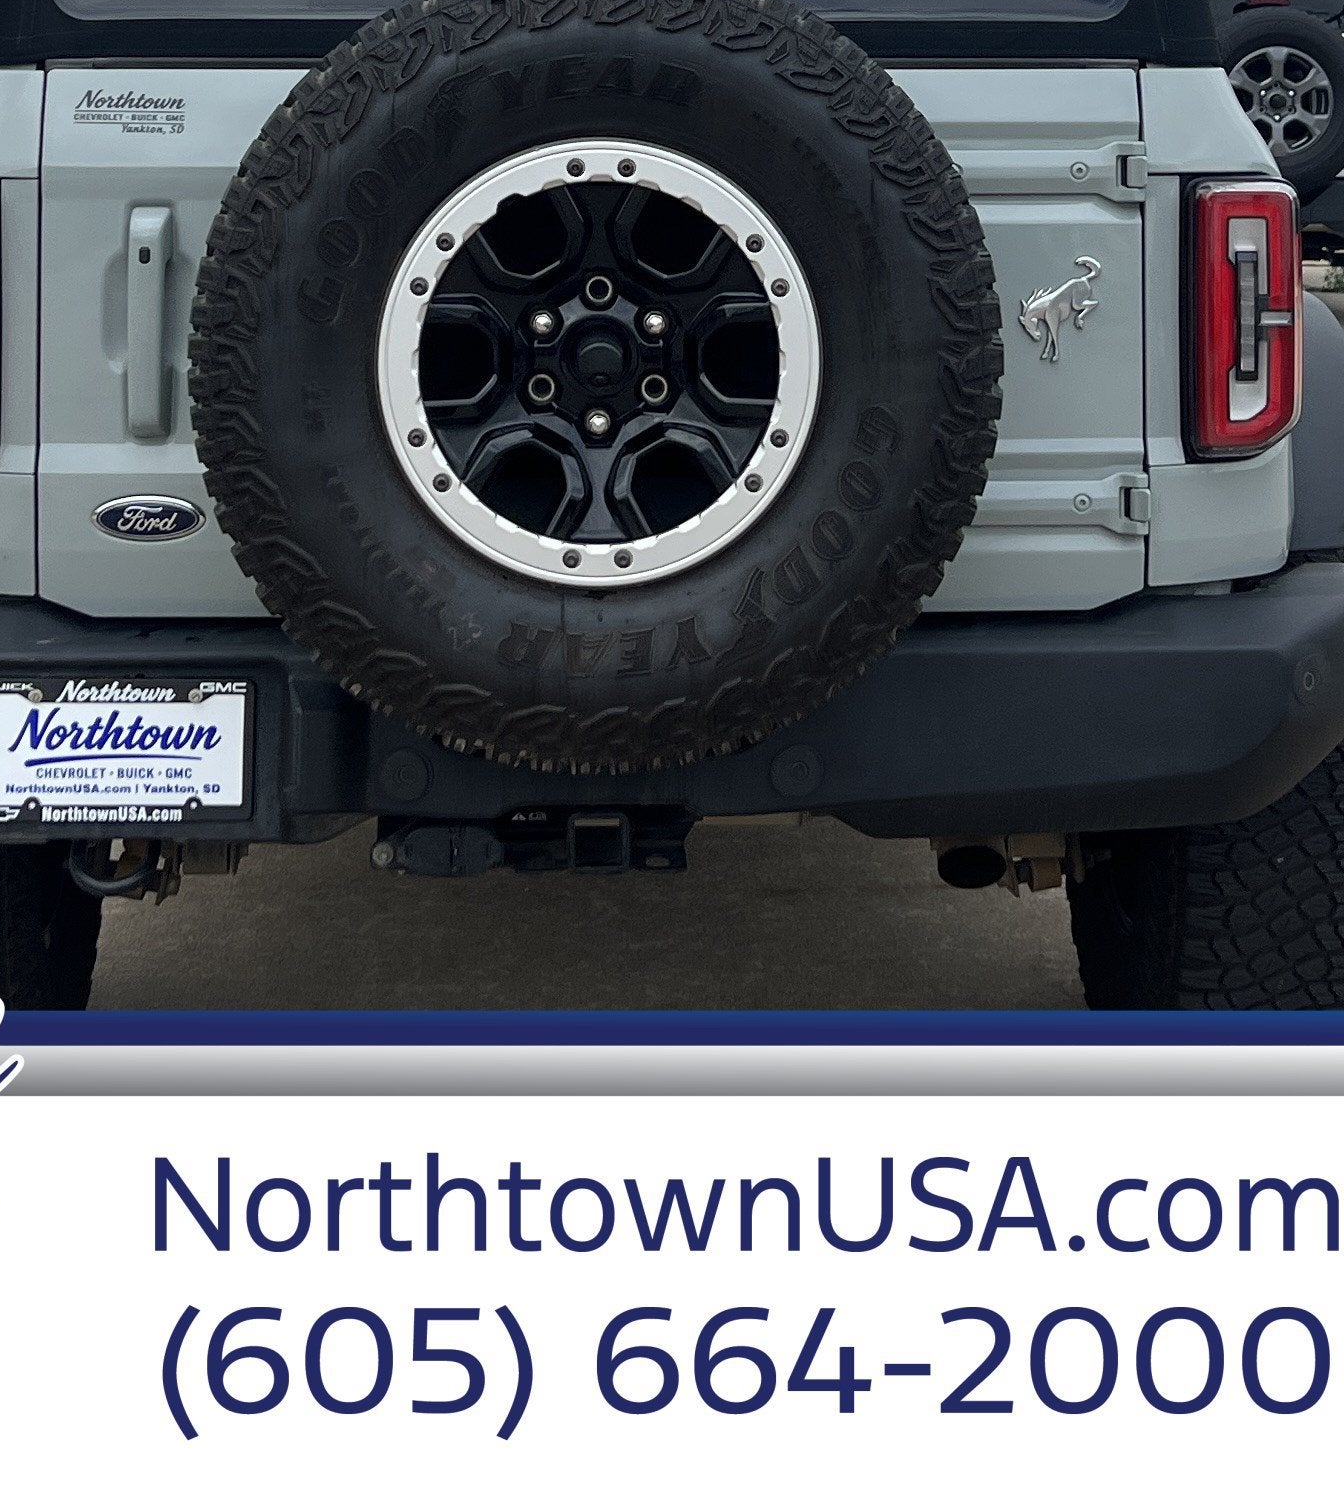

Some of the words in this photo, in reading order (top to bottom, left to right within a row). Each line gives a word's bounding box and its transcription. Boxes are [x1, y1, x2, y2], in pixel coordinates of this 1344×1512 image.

[74, 89, 187, 109] Northtown
[73, 113, 124, 122] CHEVROLET
[131, 114, 158, 122] BUICK
[165, 114, 186, 122] GMC
[170, 123, 185, 134] SD
[117, 506, 178, 531] Ford
[496, 404, 902, 677] GOODYEAR
[56, 679, 176, 703] Northtown
[199, 681, 247, 693] GMC
[8, 707, 222, 752] Northtown
[36, 767, 106, 779] CHEVROLET
[117, 767, 154, 779] BUICK
[166, 767, 193, 779] GMC
[5, 784, 132, 794] NorthtownUSA.com
[143, 784, 199, 795] Yankton,
[203, 784, 221, 794] SD
[41, 806, 183, 822] NorthtownUSA.com
